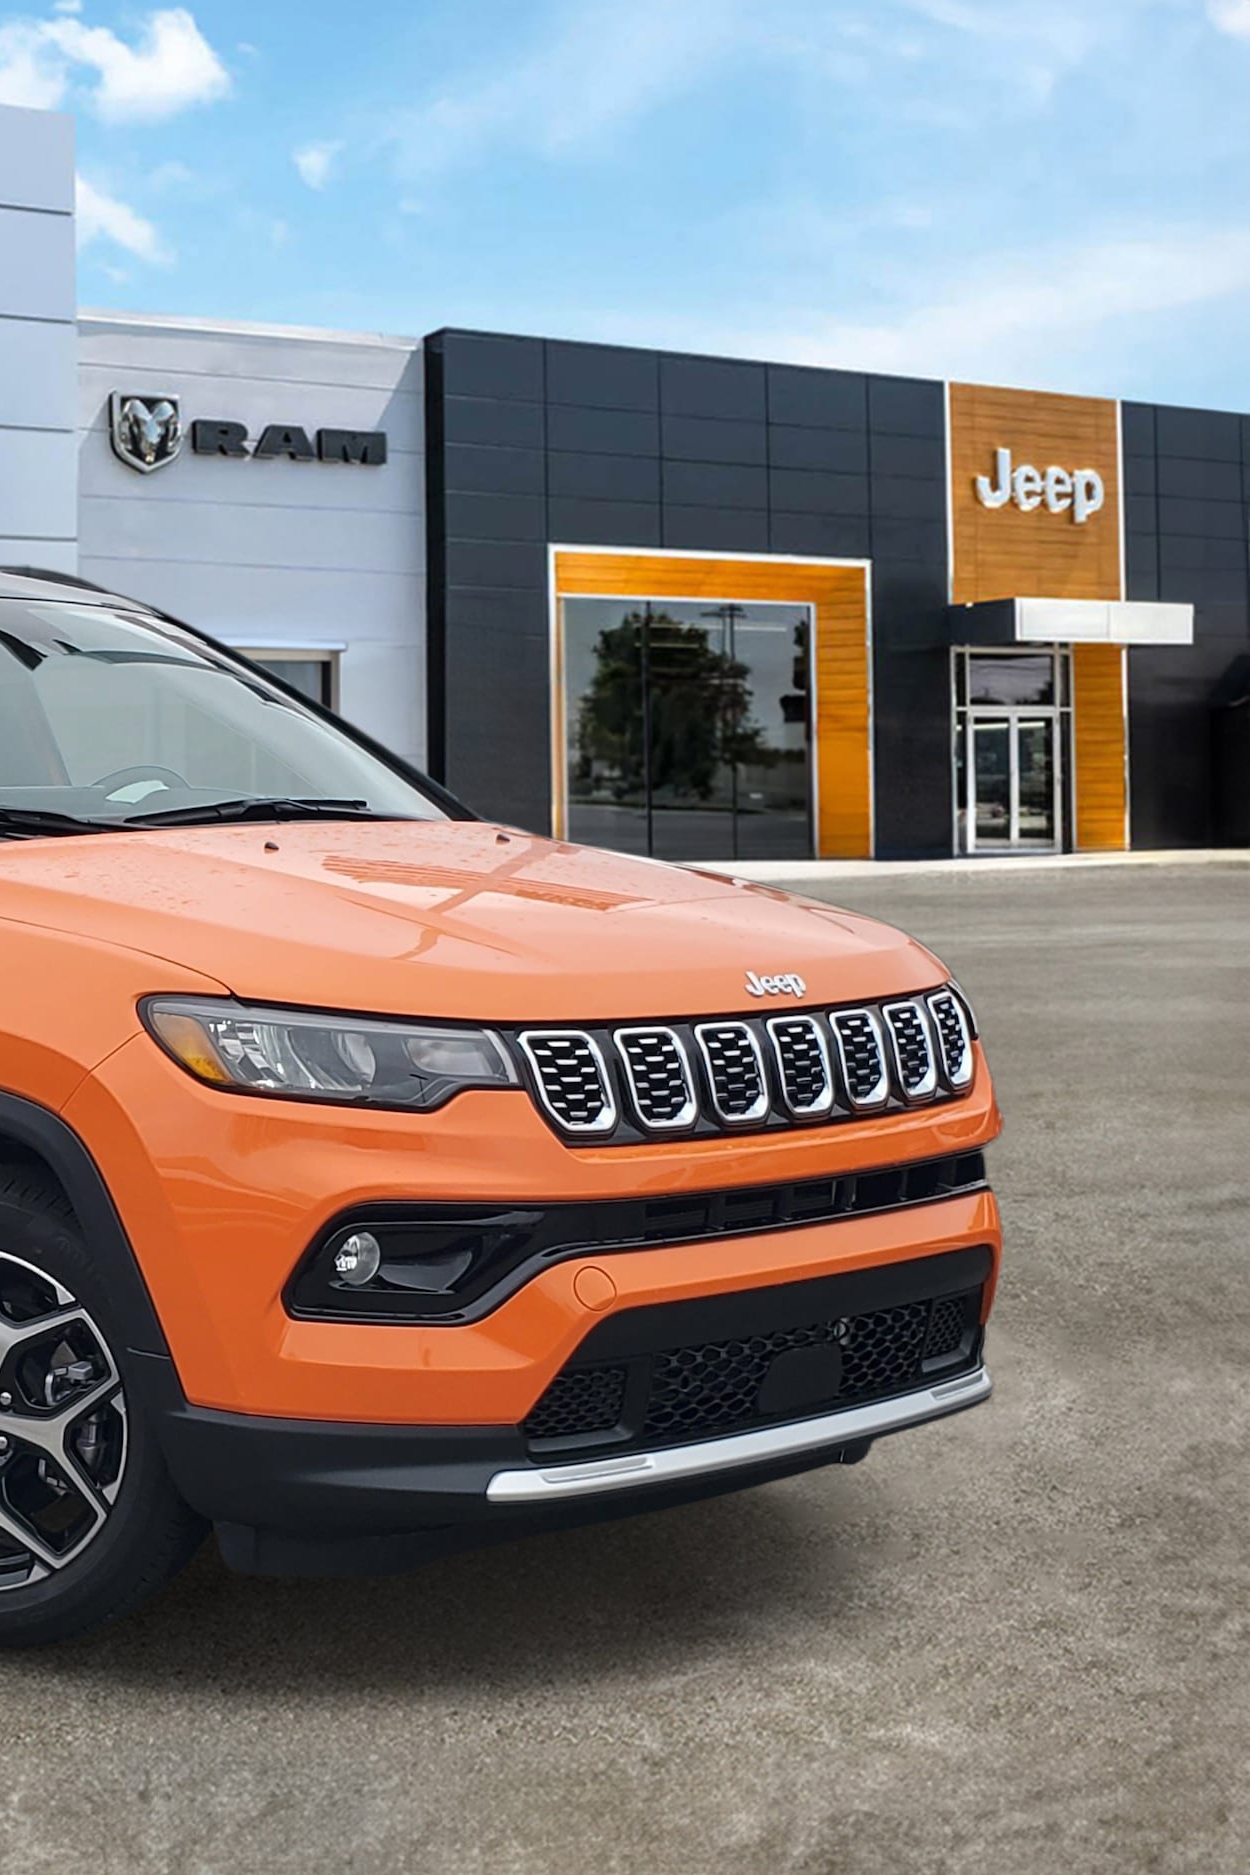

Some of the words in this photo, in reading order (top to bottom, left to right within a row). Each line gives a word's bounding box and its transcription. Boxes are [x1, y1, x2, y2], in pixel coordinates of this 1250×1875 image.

[191, 418, 387, 466] RAM
[975, 446, 1104, 524] Jeep
[744, 970, 807, 999] Jeep
